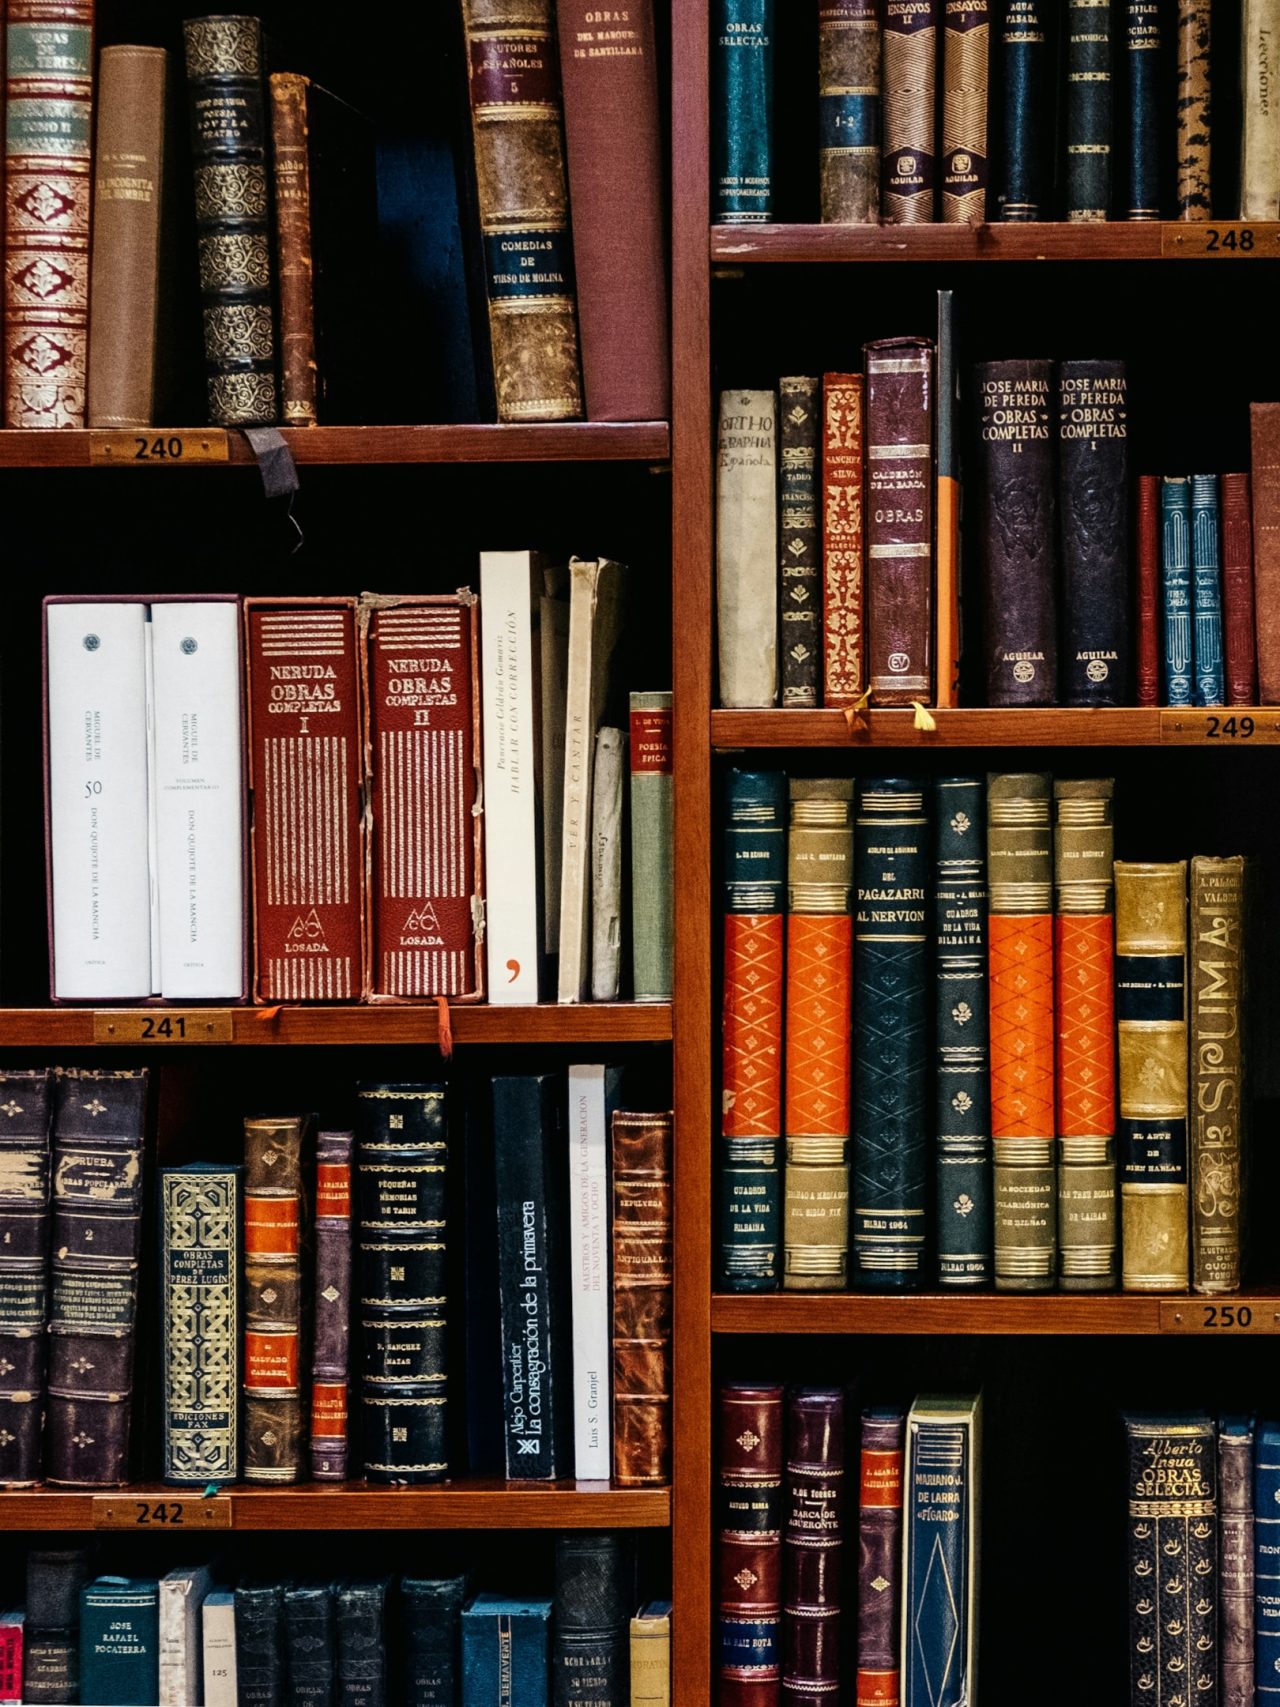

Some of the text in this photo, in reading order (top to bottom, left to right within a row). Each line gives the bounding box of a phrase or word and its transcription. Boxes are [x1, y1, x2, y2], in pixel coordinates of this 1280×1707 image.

[888, 2, 930, 15] ENSAYOS
[945, 1, 987, 14] ENSAYOS
[585, 11, 629, 22] OBRAS
[903, 16, 912, 24] II
[961, 14, 966, 23] I
[726, 23, 761, 33] OBRAS
[719, 36, 769, 46] SELECTAS
[511, 82, 518, 93] 5
[501, 241, 552, 251] COMEDIAS
[1206, 230, 1256, 250] 248
[520, 257, 534, 266] DE
[981, 380, 1049, 393] JOSE MARIA
[1060, 379, 1127, 391] JOSE MARIA
[985, 395, 1046, 407] DE PEREDA
[1063, 393, 1124, 405] DE PEREDA
[994, 411, 1037, 423] OBRAS
[1072, 409, 1115, 421] OBRAS
[982, 425, 1048, 440] COMPLETAS
[1060, 424, 1127, 438] COMPLETAS
[134, 437, 182, 458] 240
[1012, 444, 1022, 452] II
[1091, 441, 1096, 450] I
[875, 509, 923, 522] OBRAS
[1076, 652, 1118, 660] AGUILAR
[388, 659, 453, 674] NERUDA
[270, 666, 336, 680] NERUDA
[271, 684, 334, 699] OBRAS
[389, 677, 451, 694] OBRAS
[386, 694, 457, 707] COMPLETAS
[268, 701, 341, 713] COMPLETAS
[414, 711, 429, 725] II
[300, 717, 309, 733] I
[1208, 716, 1254, 738] 249
[94, 748, 100, 759] DE
[85, 781, 102, 798] 50
[90, 831, 98, 868] QUIJOTE
[92, 872, 98, 883] DE
[92, 887, 98, 897] LA
[858, 888, 925, 901] PAGAZARRI
[857, 910, 924, 922] AL NERVION
[400, 936, 443, 945] LOSADA
[285, 943, 329, 952] LOSADA
[142, 1018, 186, 1038] 241
[184, 1252, 213, 1260] OBRAS
[174, 1260, 224, 1268] COMPLETAS
[520, 1200, 545, 1435] La consagración de la primavera
[1204, 1306, 1251, 1327] 250
[509, 1343, 528, 1434] Alejo Carpentier
[587, 1371, 599, 1409] Granjel
[173, 1413, 225, 1421] EDICIONES
[588, 1428, 599, 1448] Luis
[1144, 1441, 1203, 1455] Alberto
[1151, 1456, 1195, 1467] Insua
[915, 1474, 963, 1484] MARIANO J.
[1142, 1469, 1201, 1482] OBRAS
[1136, 1483, 1210, 1496] SELECTAS
[918, 1492, 960, 1502] DE LARRA
[136, 1504, 183, 1524] 242
[109, 1622, 131, 1630] JOSE
[102, 1634, 138, 1642] RAFAEL
[95, 1645, 147, 1655] POCATERRA
